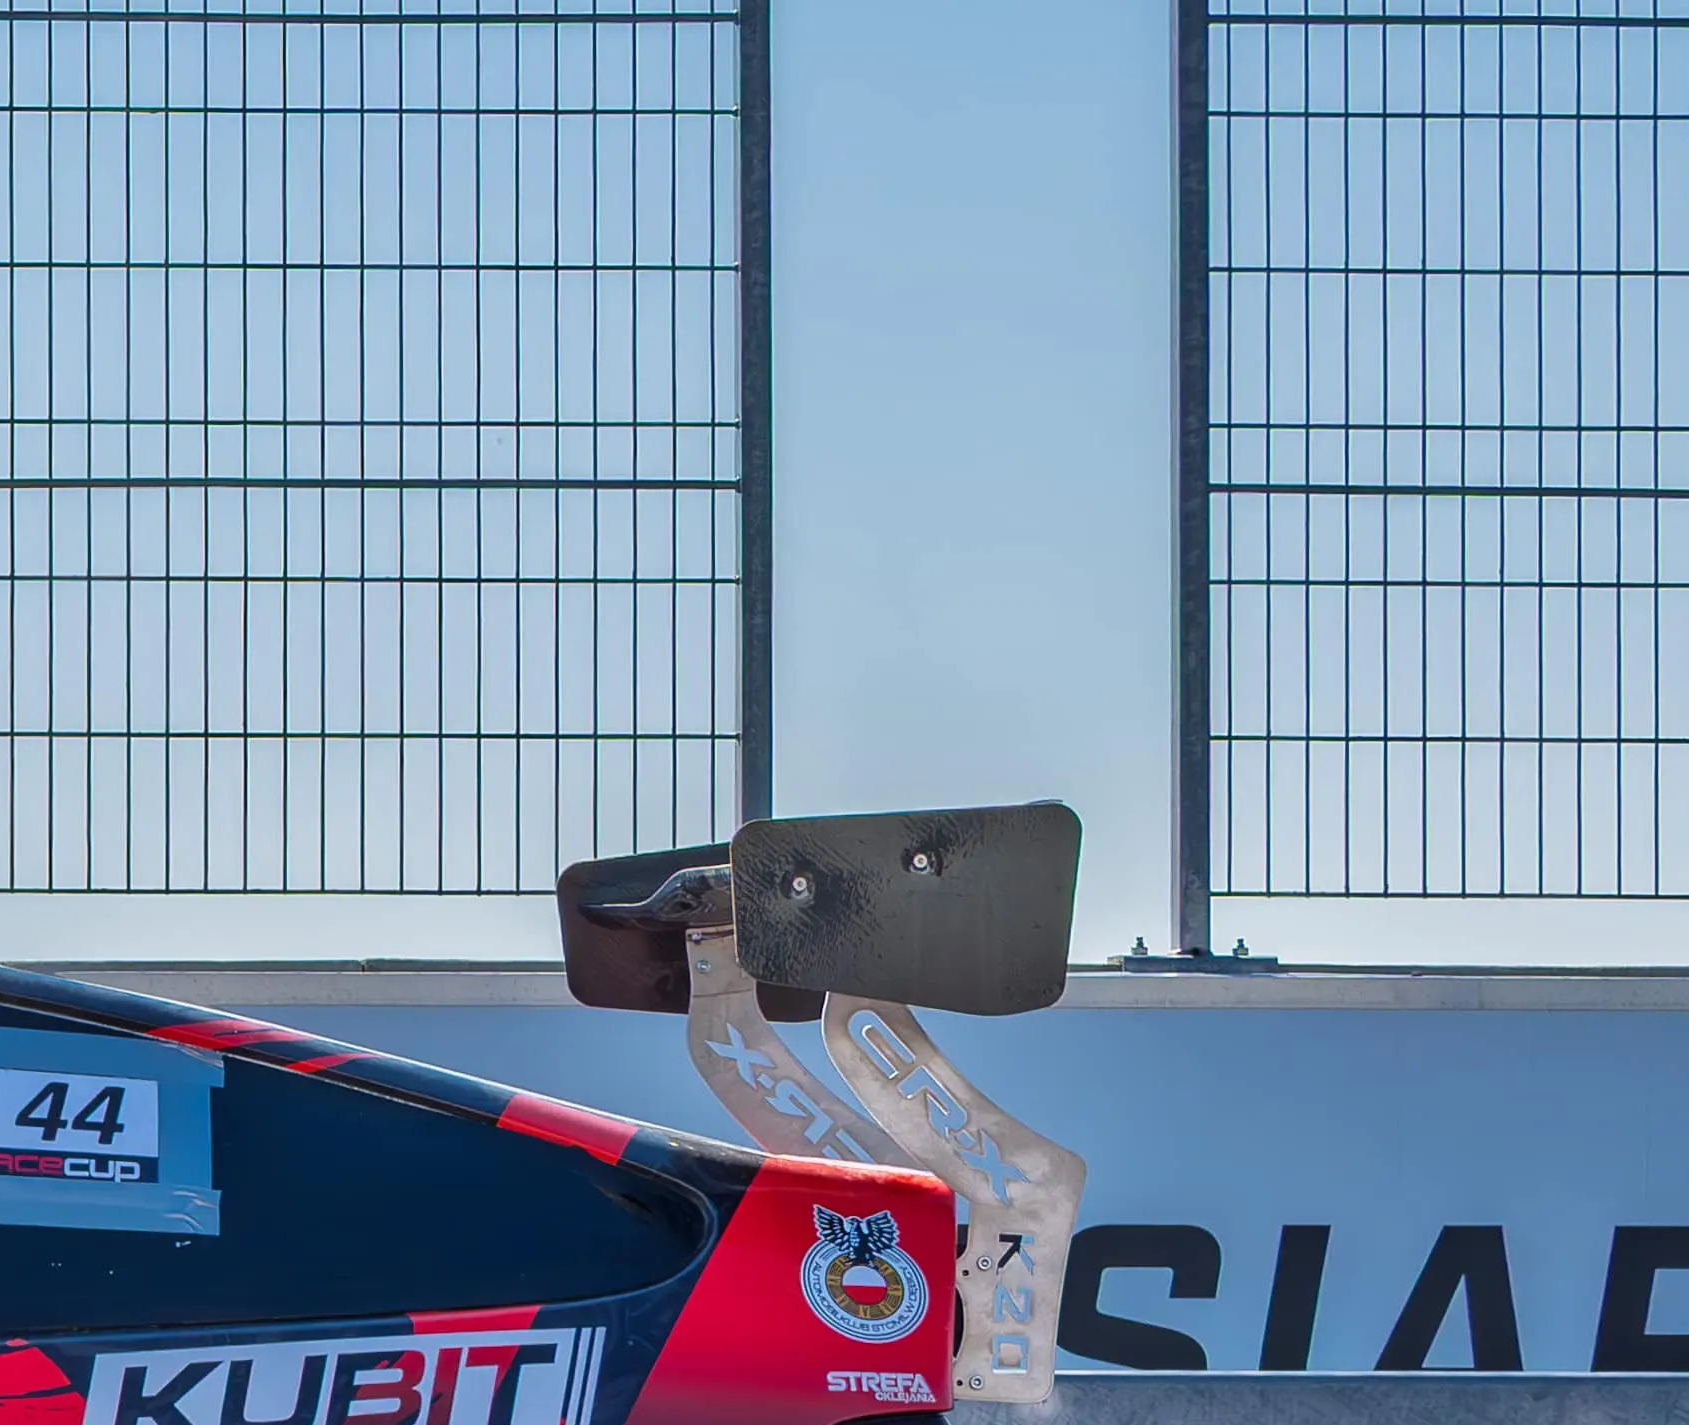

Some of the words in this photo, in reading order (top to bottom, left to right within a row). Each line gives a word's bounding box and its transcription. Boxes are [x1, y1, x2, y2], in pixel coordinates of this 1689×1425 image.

[14, 1081, 126, 1145] 44
[992, 1232, 1035, 1374] K20
[826, 1371, 931, 1393] STREFA
